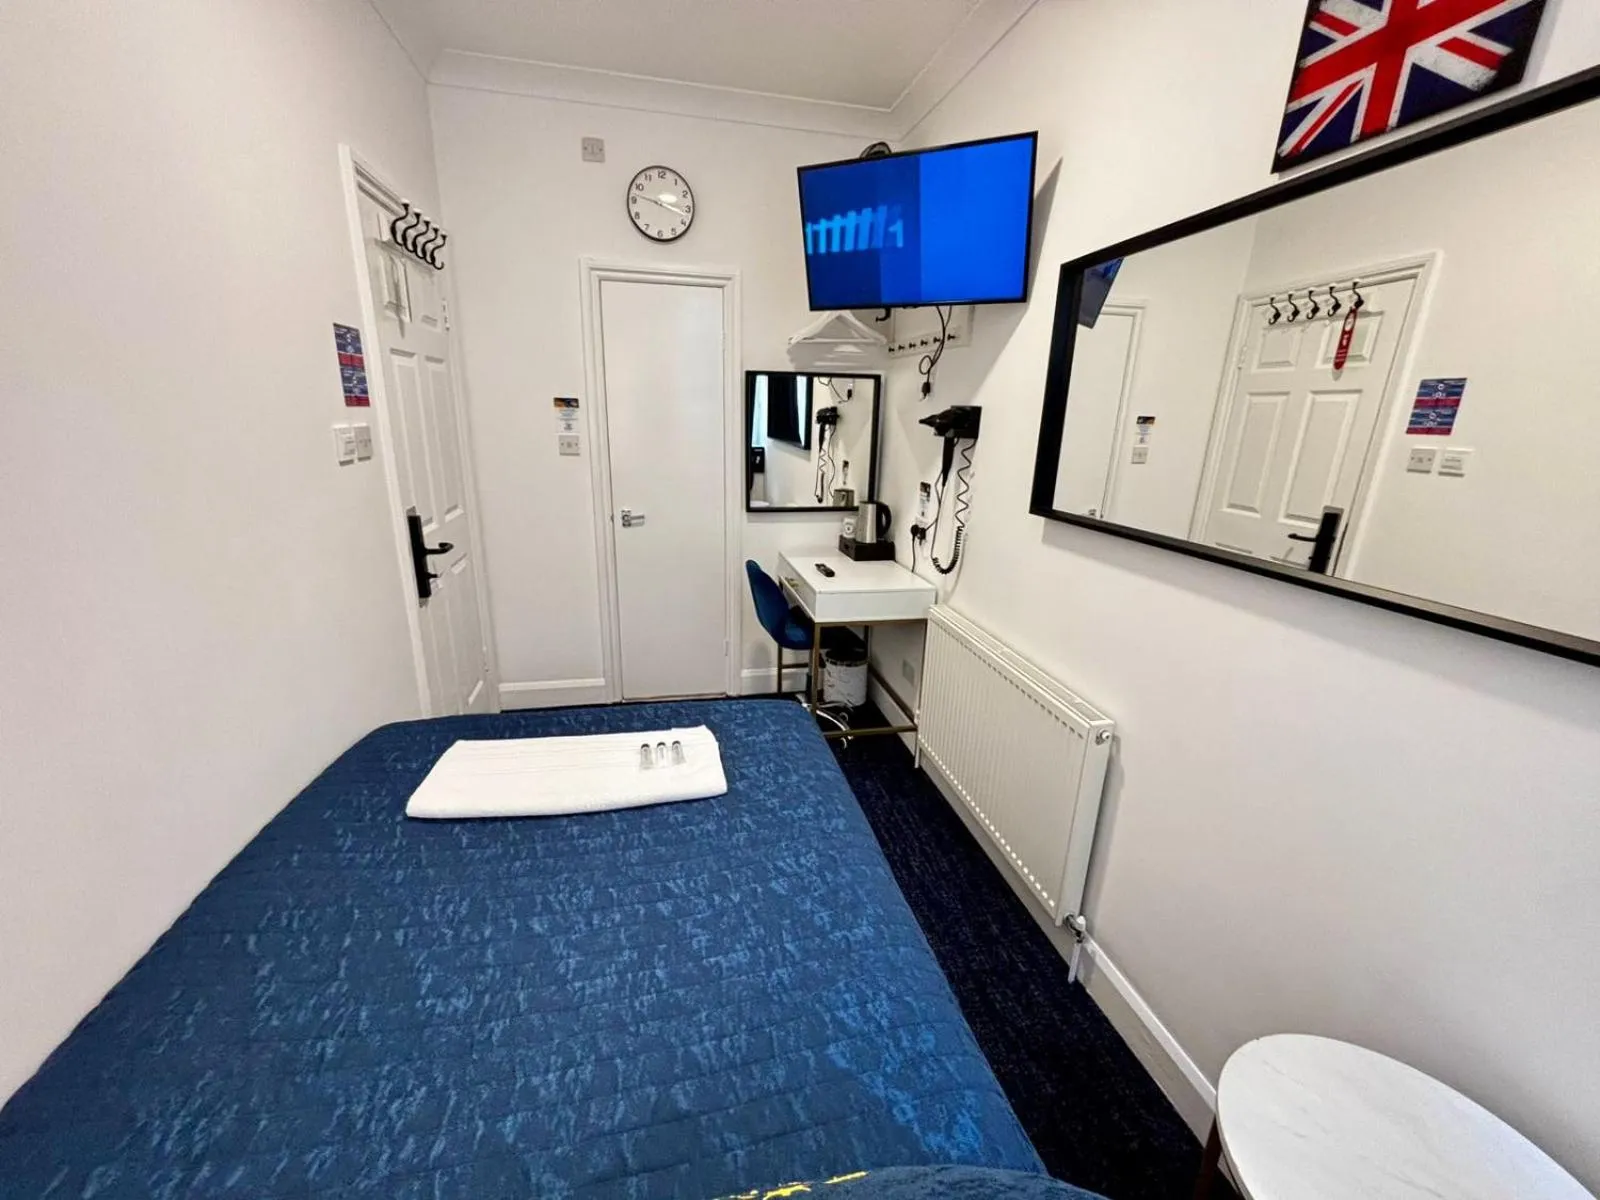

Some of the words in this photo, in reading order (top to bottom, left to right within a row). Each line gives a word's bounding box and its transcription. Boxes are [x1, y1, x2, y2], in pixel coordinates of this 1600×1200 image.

[644, 173, 652, 182] 11
[657, 170, 666, 179] 12
[635, 183, 644, 191] 10
[682, 190, 688, 198] 2
[631, 196, 637, 204] 9
[685, 205, 691, 213] 3
[634, 211, 640, 219] 8
[680, 218, 687, 227] 4
[657, 230, 663, 238] 6
[671, 227, 677, 236] 5
